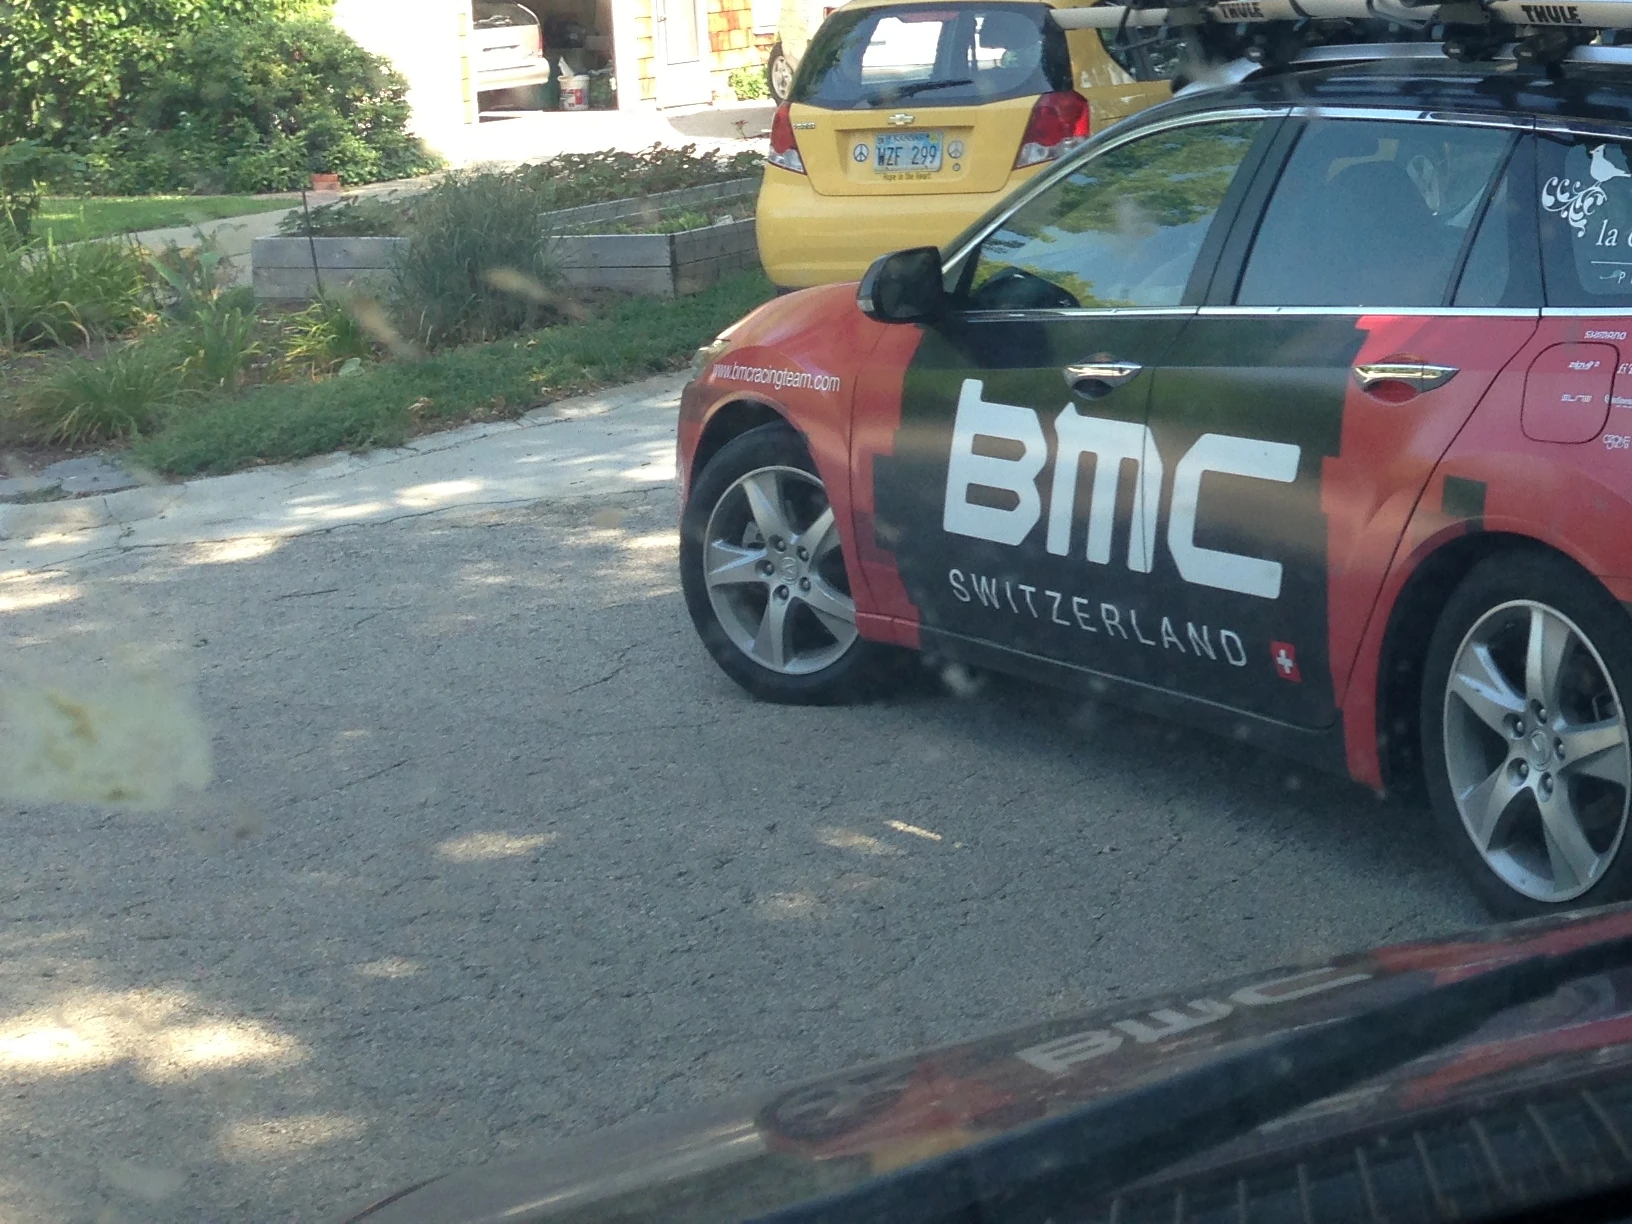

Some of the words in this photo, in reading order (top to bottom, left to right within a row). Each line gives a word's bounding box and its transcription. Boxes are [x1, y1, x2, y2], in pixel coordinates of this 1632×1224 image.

[1220, 2, 1264, 19] THULE
[1521, 4, 1582, 24] THULE
[877, 146, 903, 167] WZF
[911, 145, 937, 165] 299
[1595, 219, 1618, 247] la
[712, 361, 840, 392] www.bmcracingteam.com
[944, 378, 1301, 599] BMC
[948, 568, 1248, 668] SWITZERLAND
